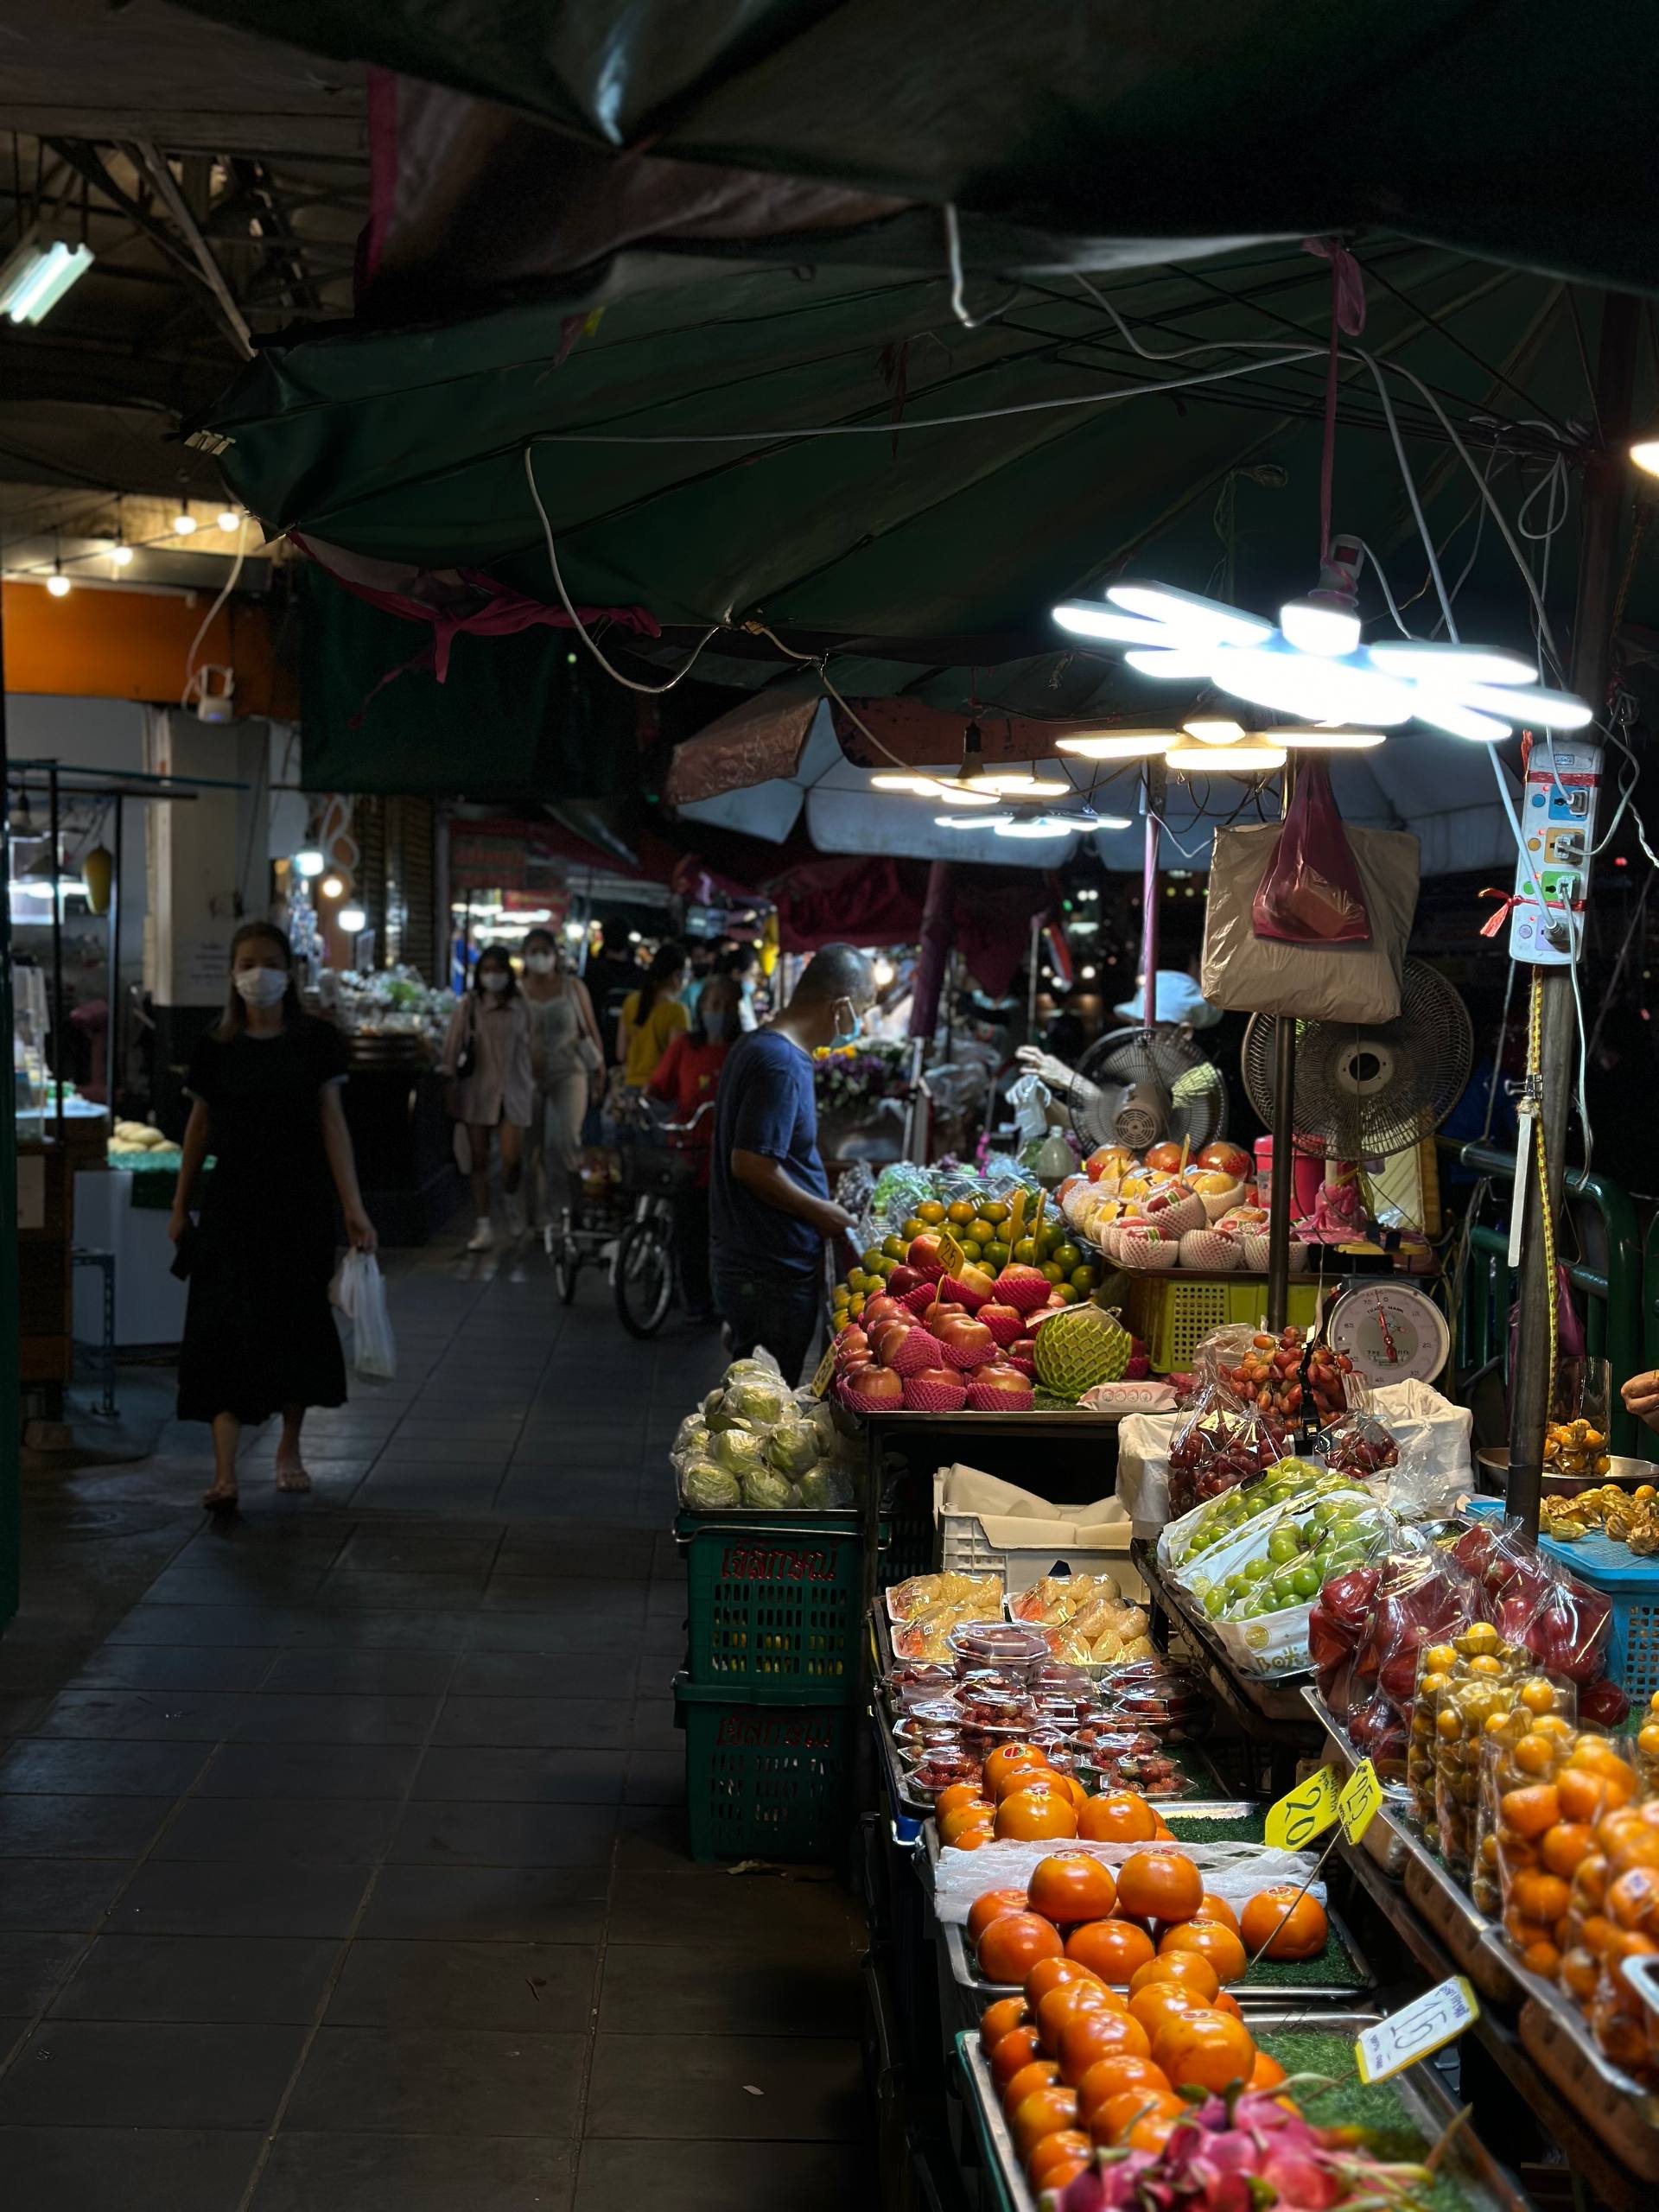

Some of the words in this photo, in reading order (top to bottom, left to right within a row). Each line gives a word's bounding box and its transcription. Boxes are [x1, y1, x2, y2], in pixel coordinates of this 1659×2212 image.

[1285, 1785, 1322, 1847] 20
[1345, 1775, 1374, 1821] 25
[1389, 1999, 1447, 2050] 15
